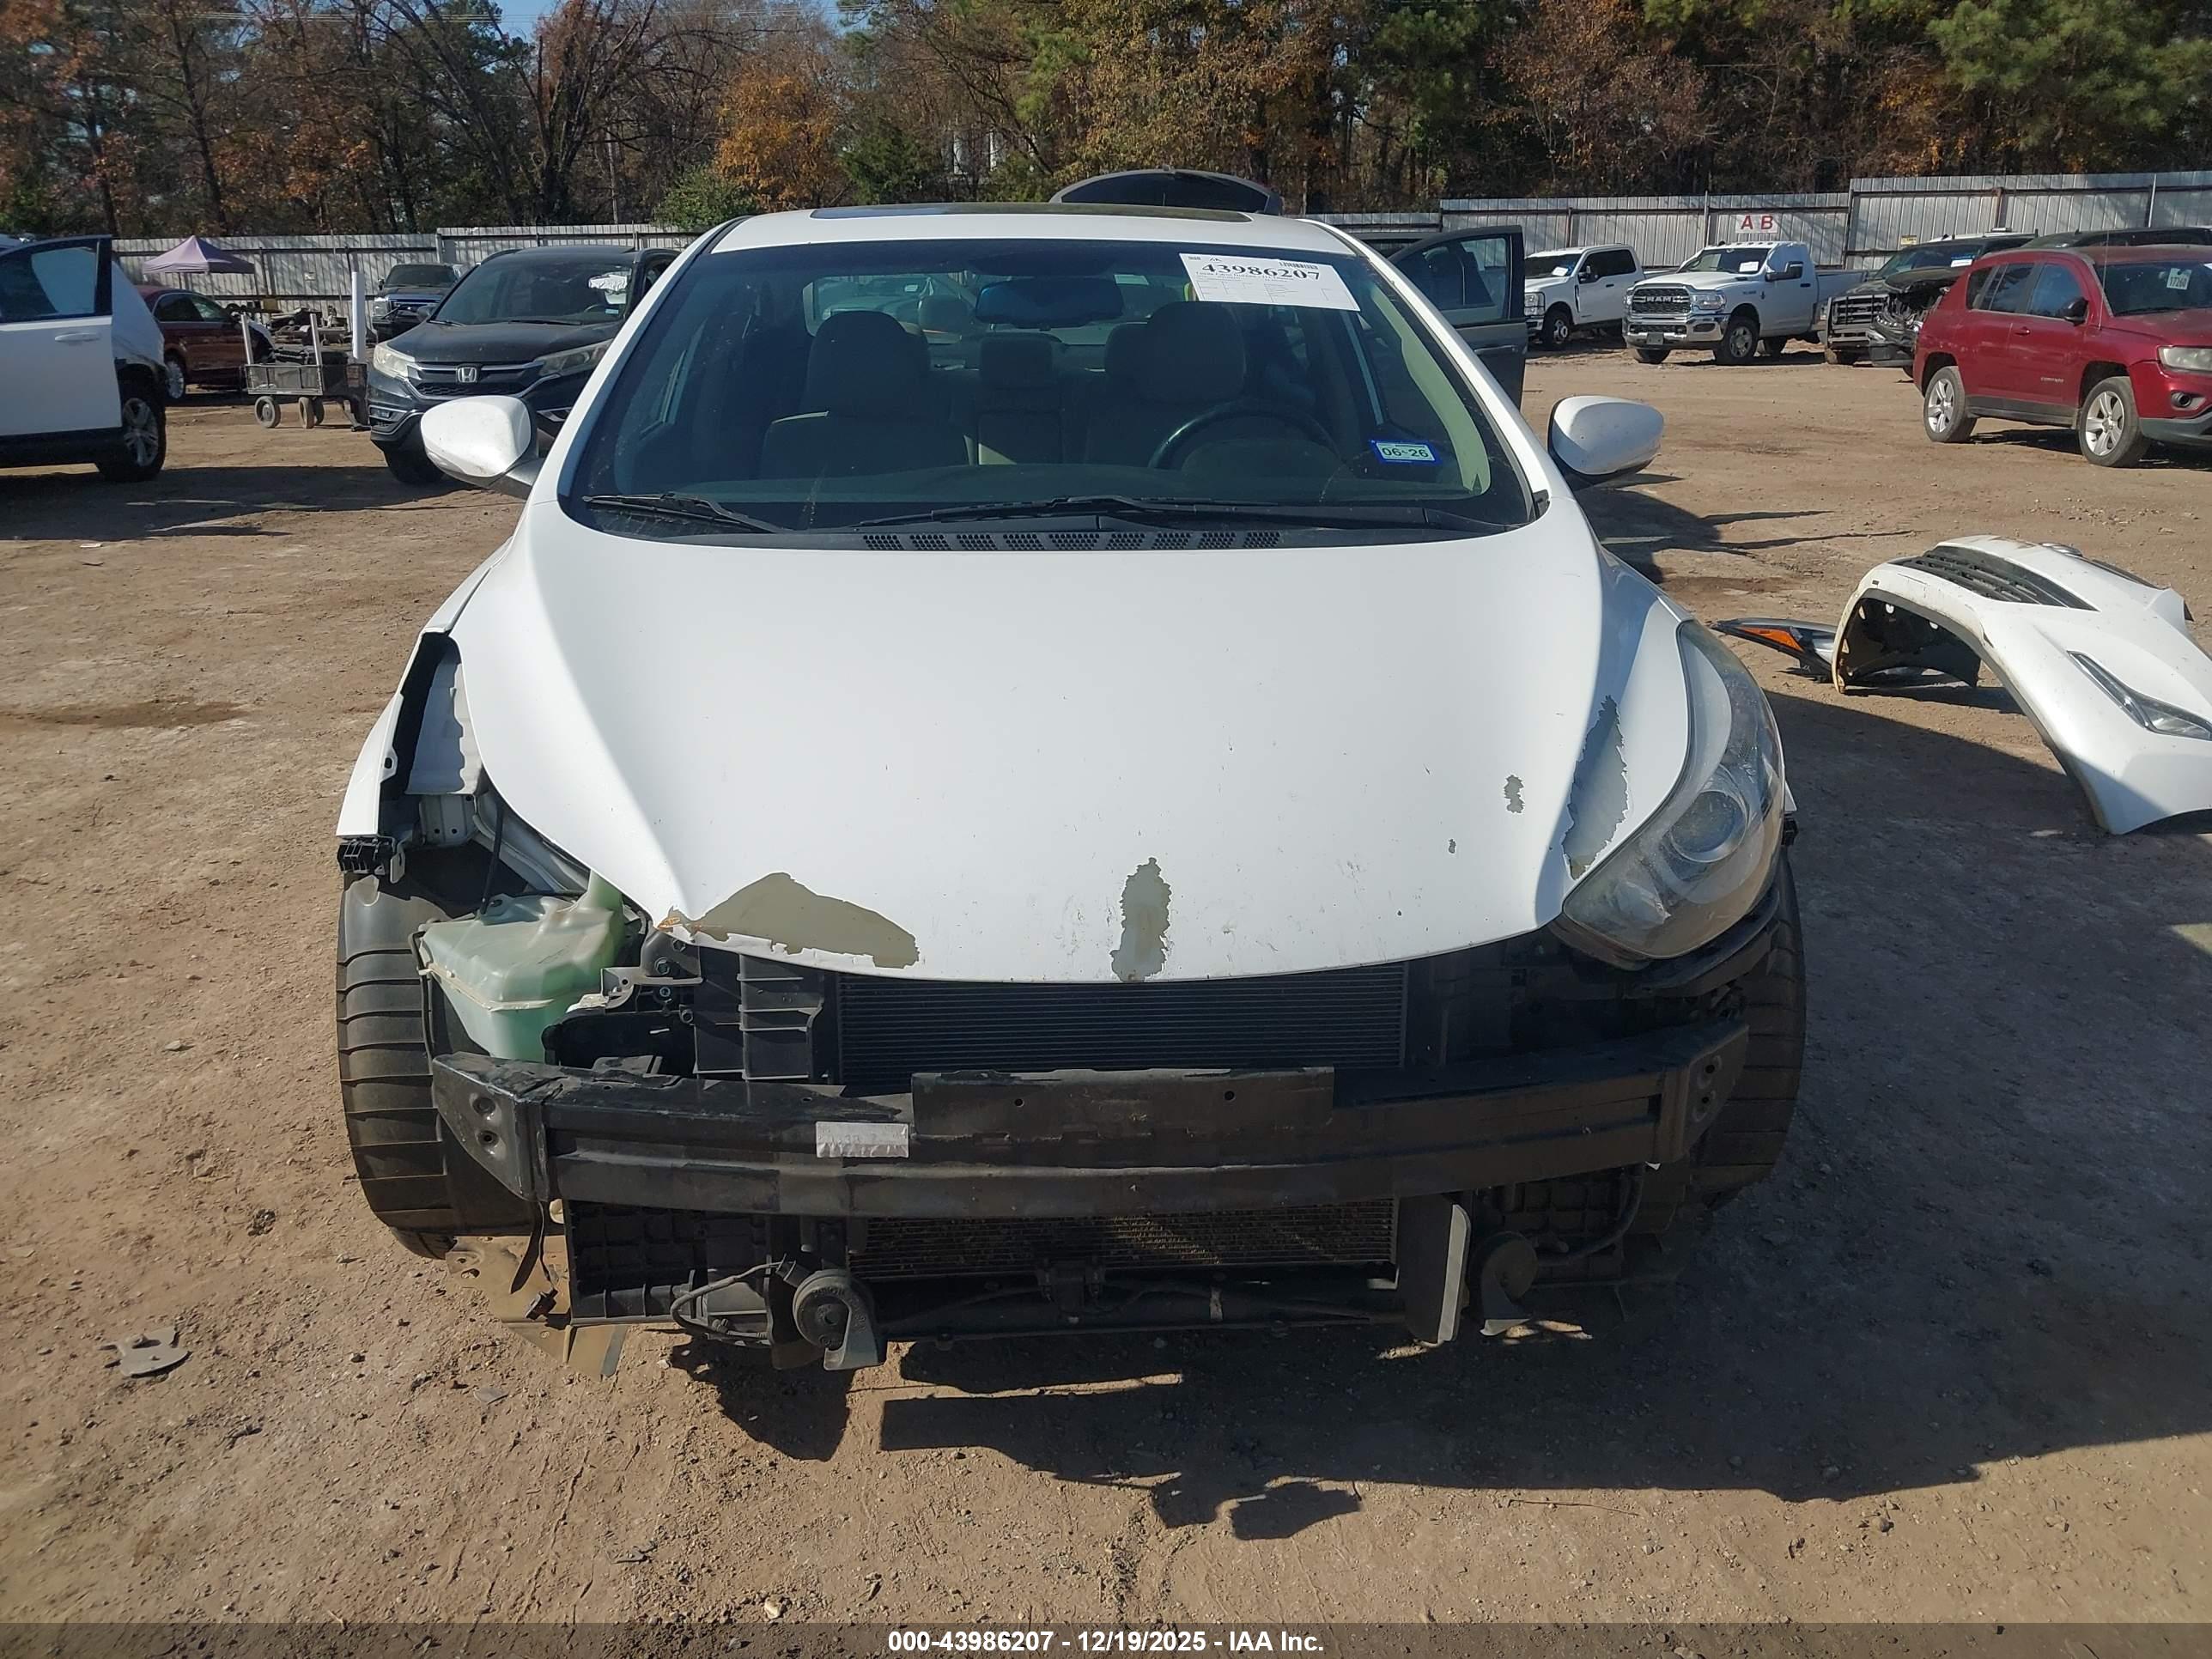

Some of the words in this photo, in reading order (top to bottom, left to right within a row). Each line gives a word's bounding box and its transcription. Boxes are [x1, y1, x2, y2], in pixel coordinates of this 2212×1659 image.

[1741, 215, 1753, 229] A
[1760, 215, 1774, 230] B
[1202, 263, 1320, 281] 43986207
